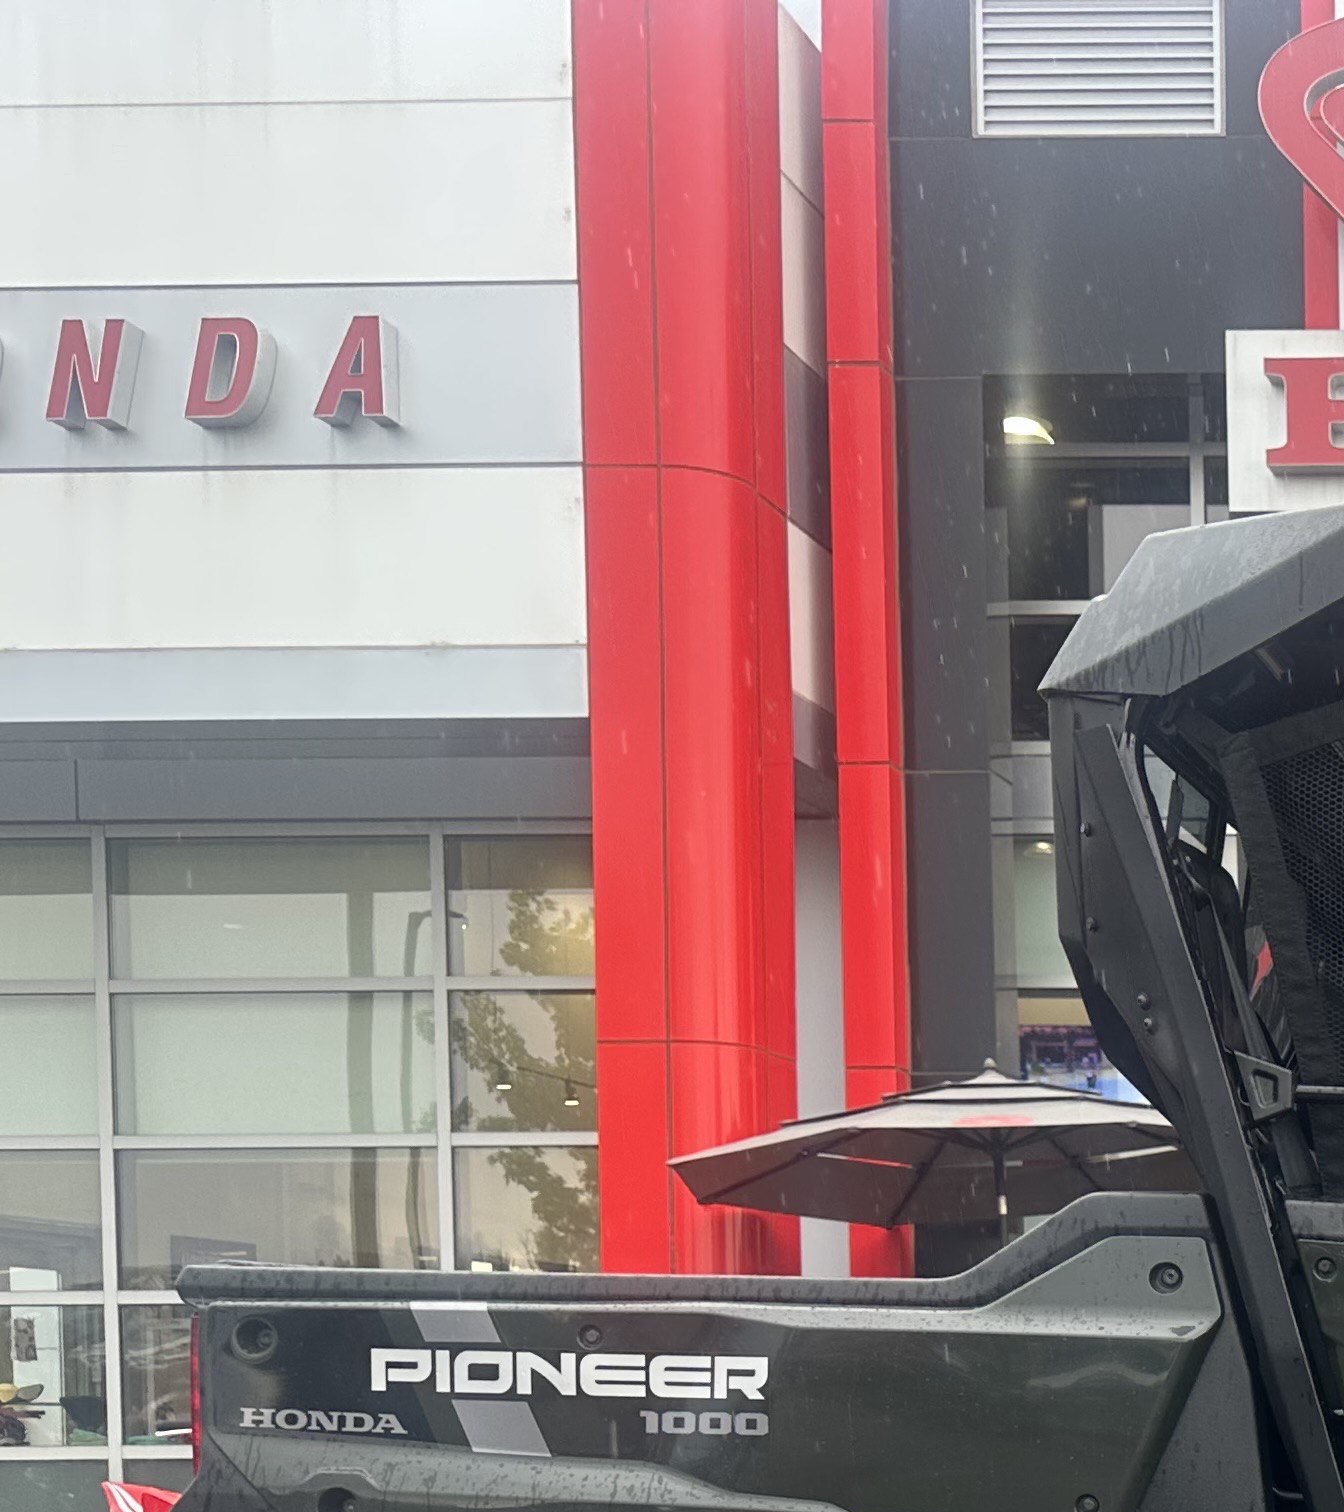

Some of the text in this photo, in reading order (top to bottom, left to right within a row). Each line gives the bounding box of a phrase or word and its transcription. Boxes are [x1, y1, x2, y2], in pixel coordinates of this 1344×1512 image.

[0, 315, 402, 430] NDA
[370, 1347, 769, 1400] PIONEER
[239, 1407, 408, 1435] HONDA
[639, 1409, 769, 1437] 1000
